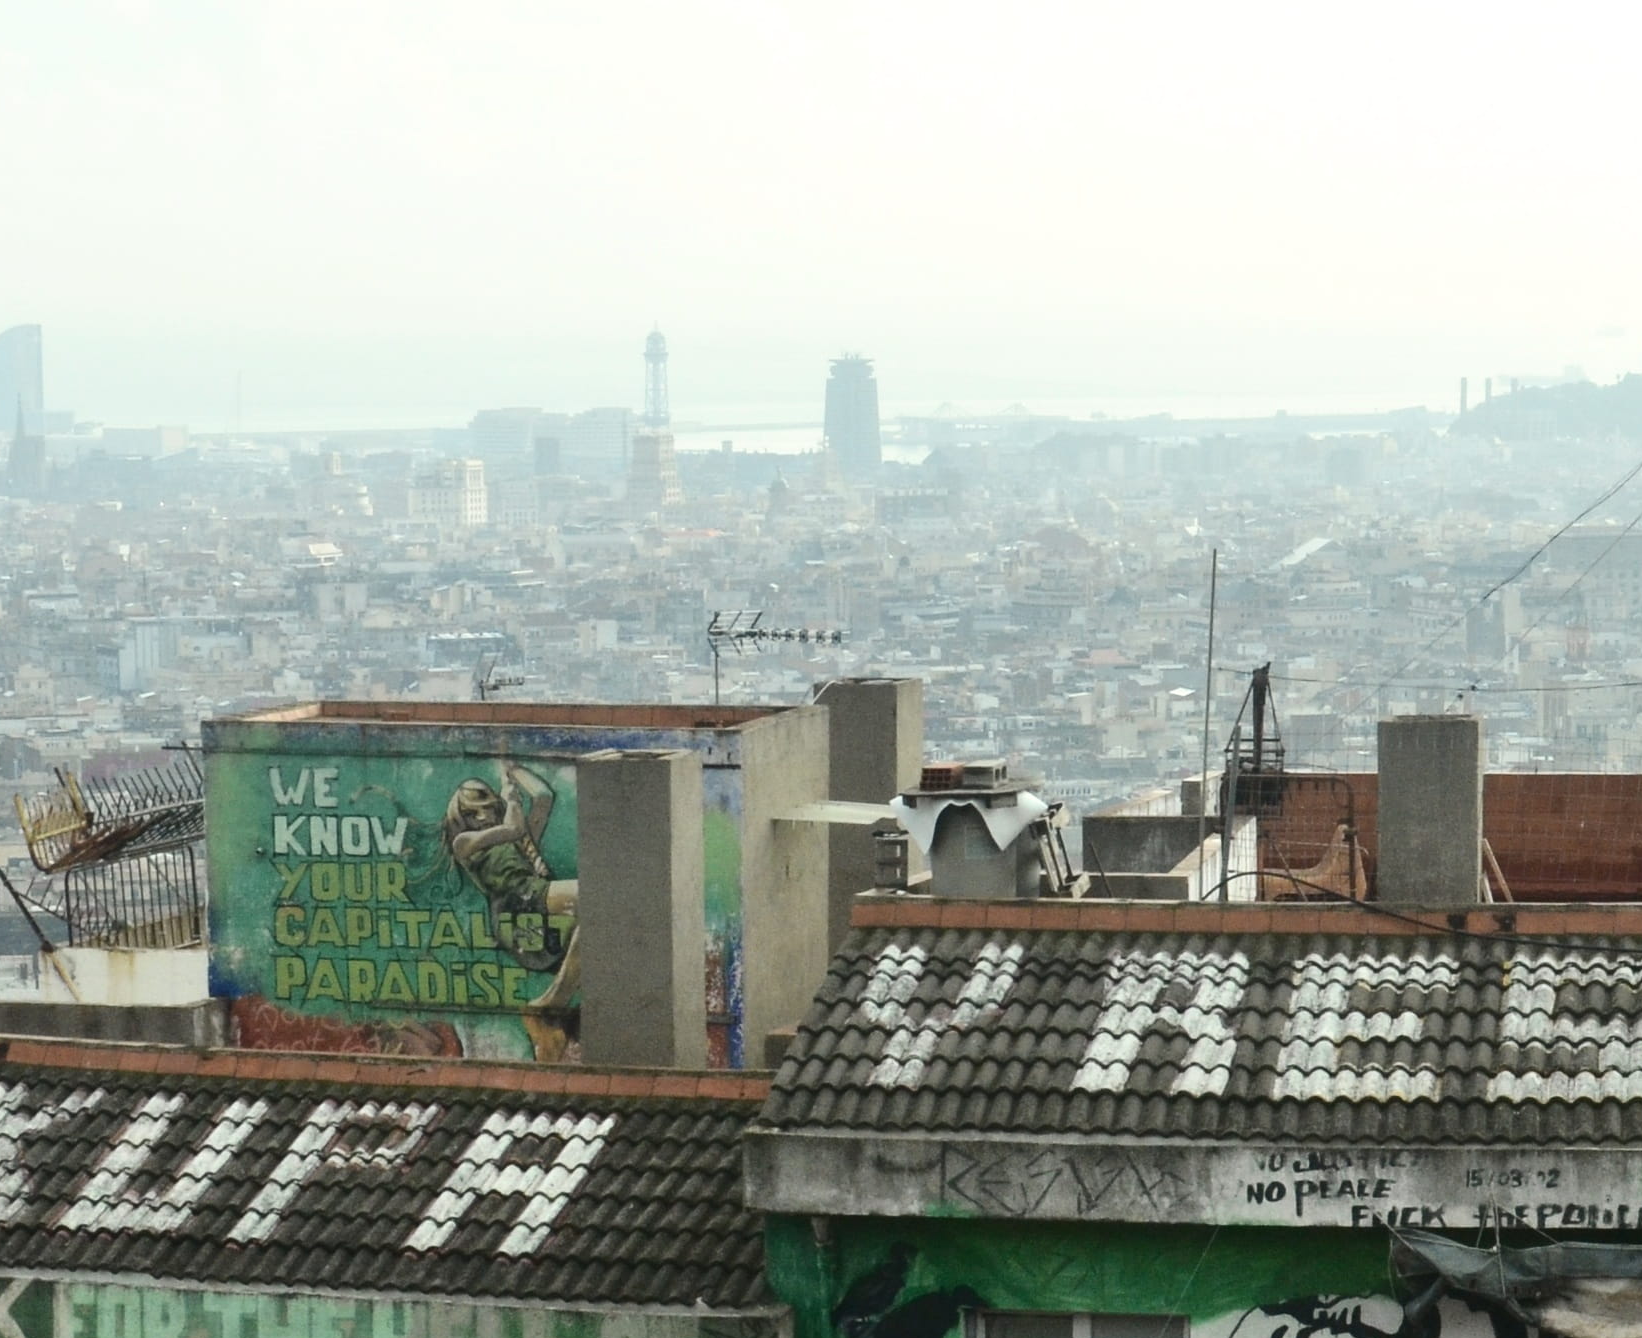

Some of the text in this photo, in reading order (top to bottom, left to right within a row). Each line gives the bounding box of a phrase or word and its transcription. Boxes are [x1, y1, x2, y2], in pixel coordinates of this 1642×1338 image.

[268, 766, 339, 808] WE
[272, 815, 408, 857] KNOW
[273, 860, 409, 903] YOUR
[1246, 1181, 1287, 1205] NO
